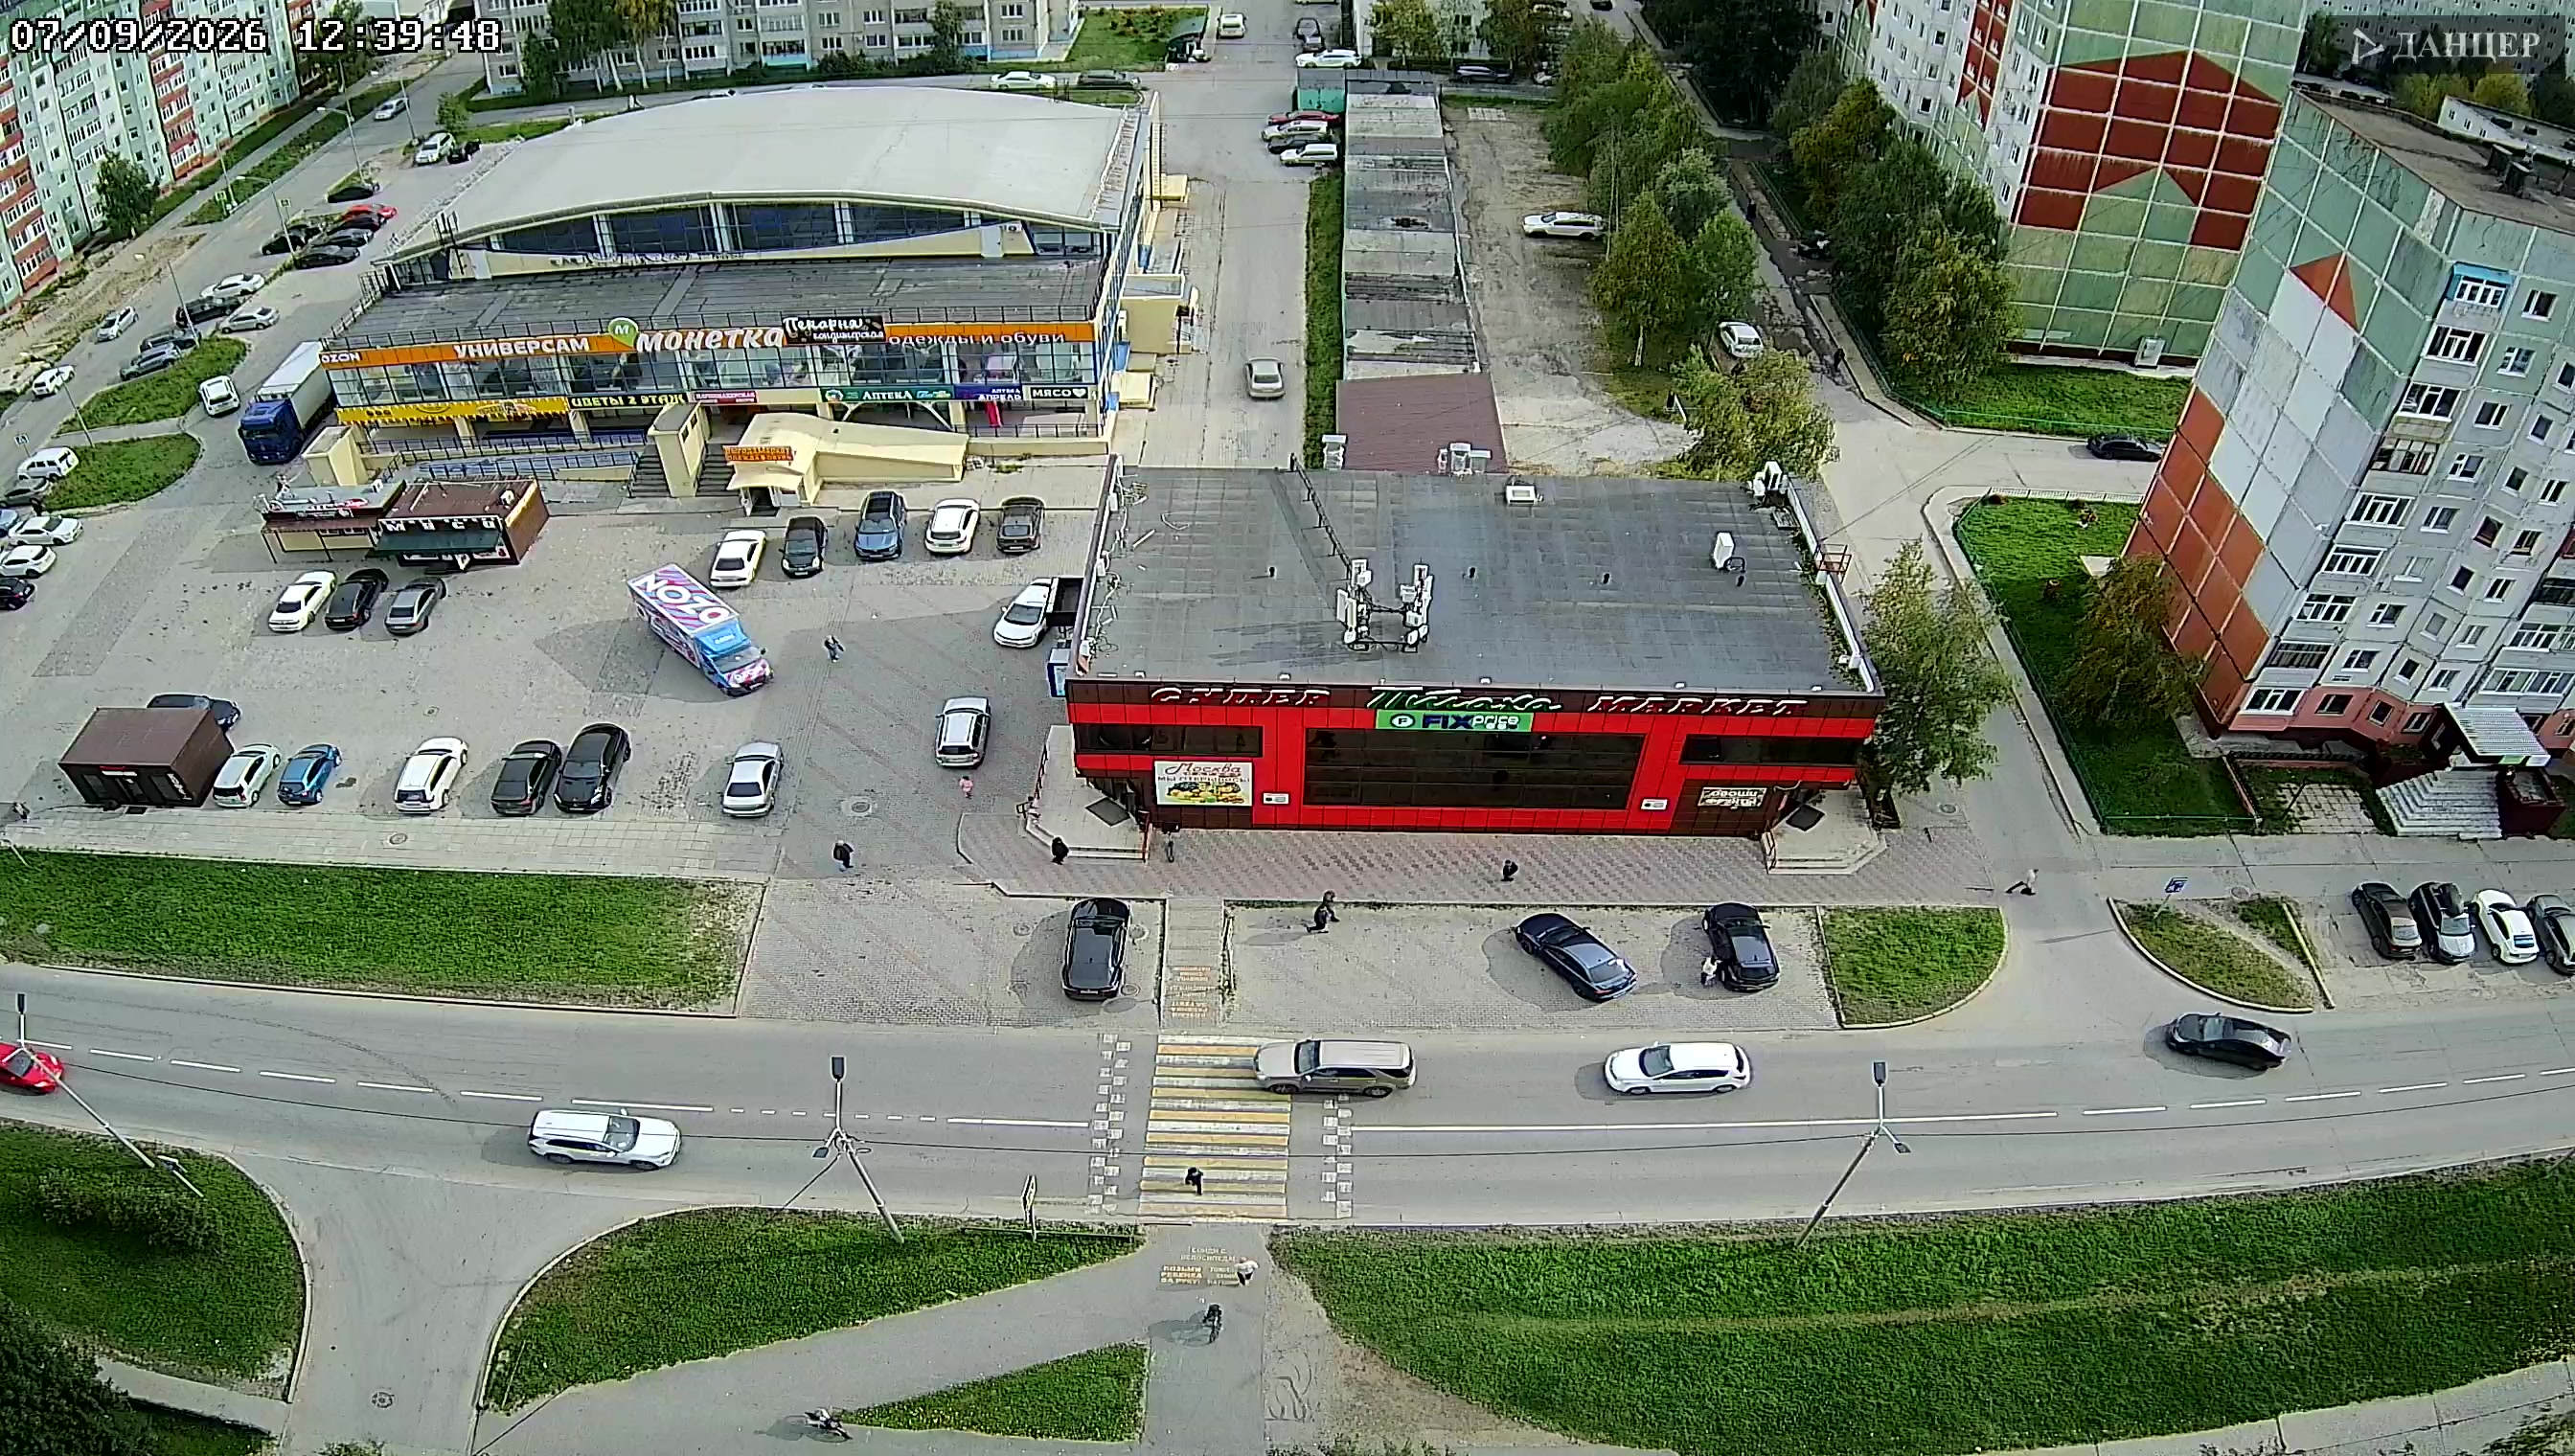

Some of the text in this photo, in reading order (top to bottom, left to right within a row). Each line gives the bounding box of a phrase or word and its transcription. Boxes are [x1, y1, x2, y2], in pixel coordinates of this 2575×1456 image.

[783, 317, 863, 332] Пекарня
[888, 331, 1065, 346] одежды и обуви
[453, 336, 590, 359] УНИВЕРСАМ
[321, 352, 362, 364] OZON
[1032, 389, 1072, 398] МЯСО
[571, 397, 624, 408] ЦВЕТЫ
[628, 398, 637, 406] 2
[633, 572, 731, 625] OZON
[1423, 715, 1474, 729] FIX
[1472, 715, 1520, 726] price
[1165, 762, 1242, 775] Москва
